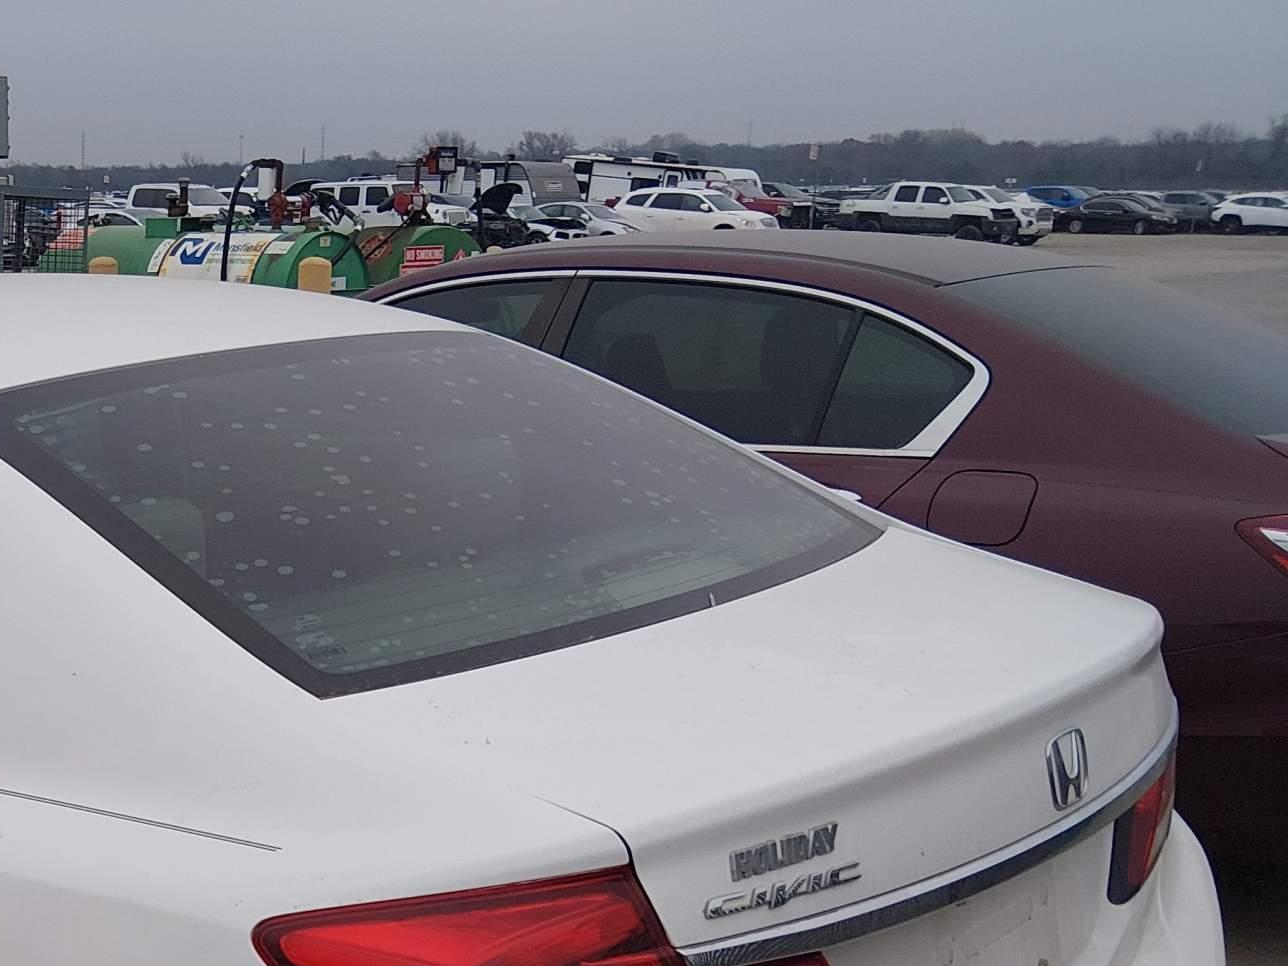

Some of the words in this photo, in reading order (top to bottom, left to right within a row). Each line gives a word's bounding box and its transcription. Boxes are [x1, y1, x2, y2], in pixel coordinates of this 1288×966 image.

[406, 250, 415, 260] NO
[416, 249, 442, 259] SMOKING
[729, 821, 839, 882] HOLIDAY
[702, 862, 863, 919] CIVIC
